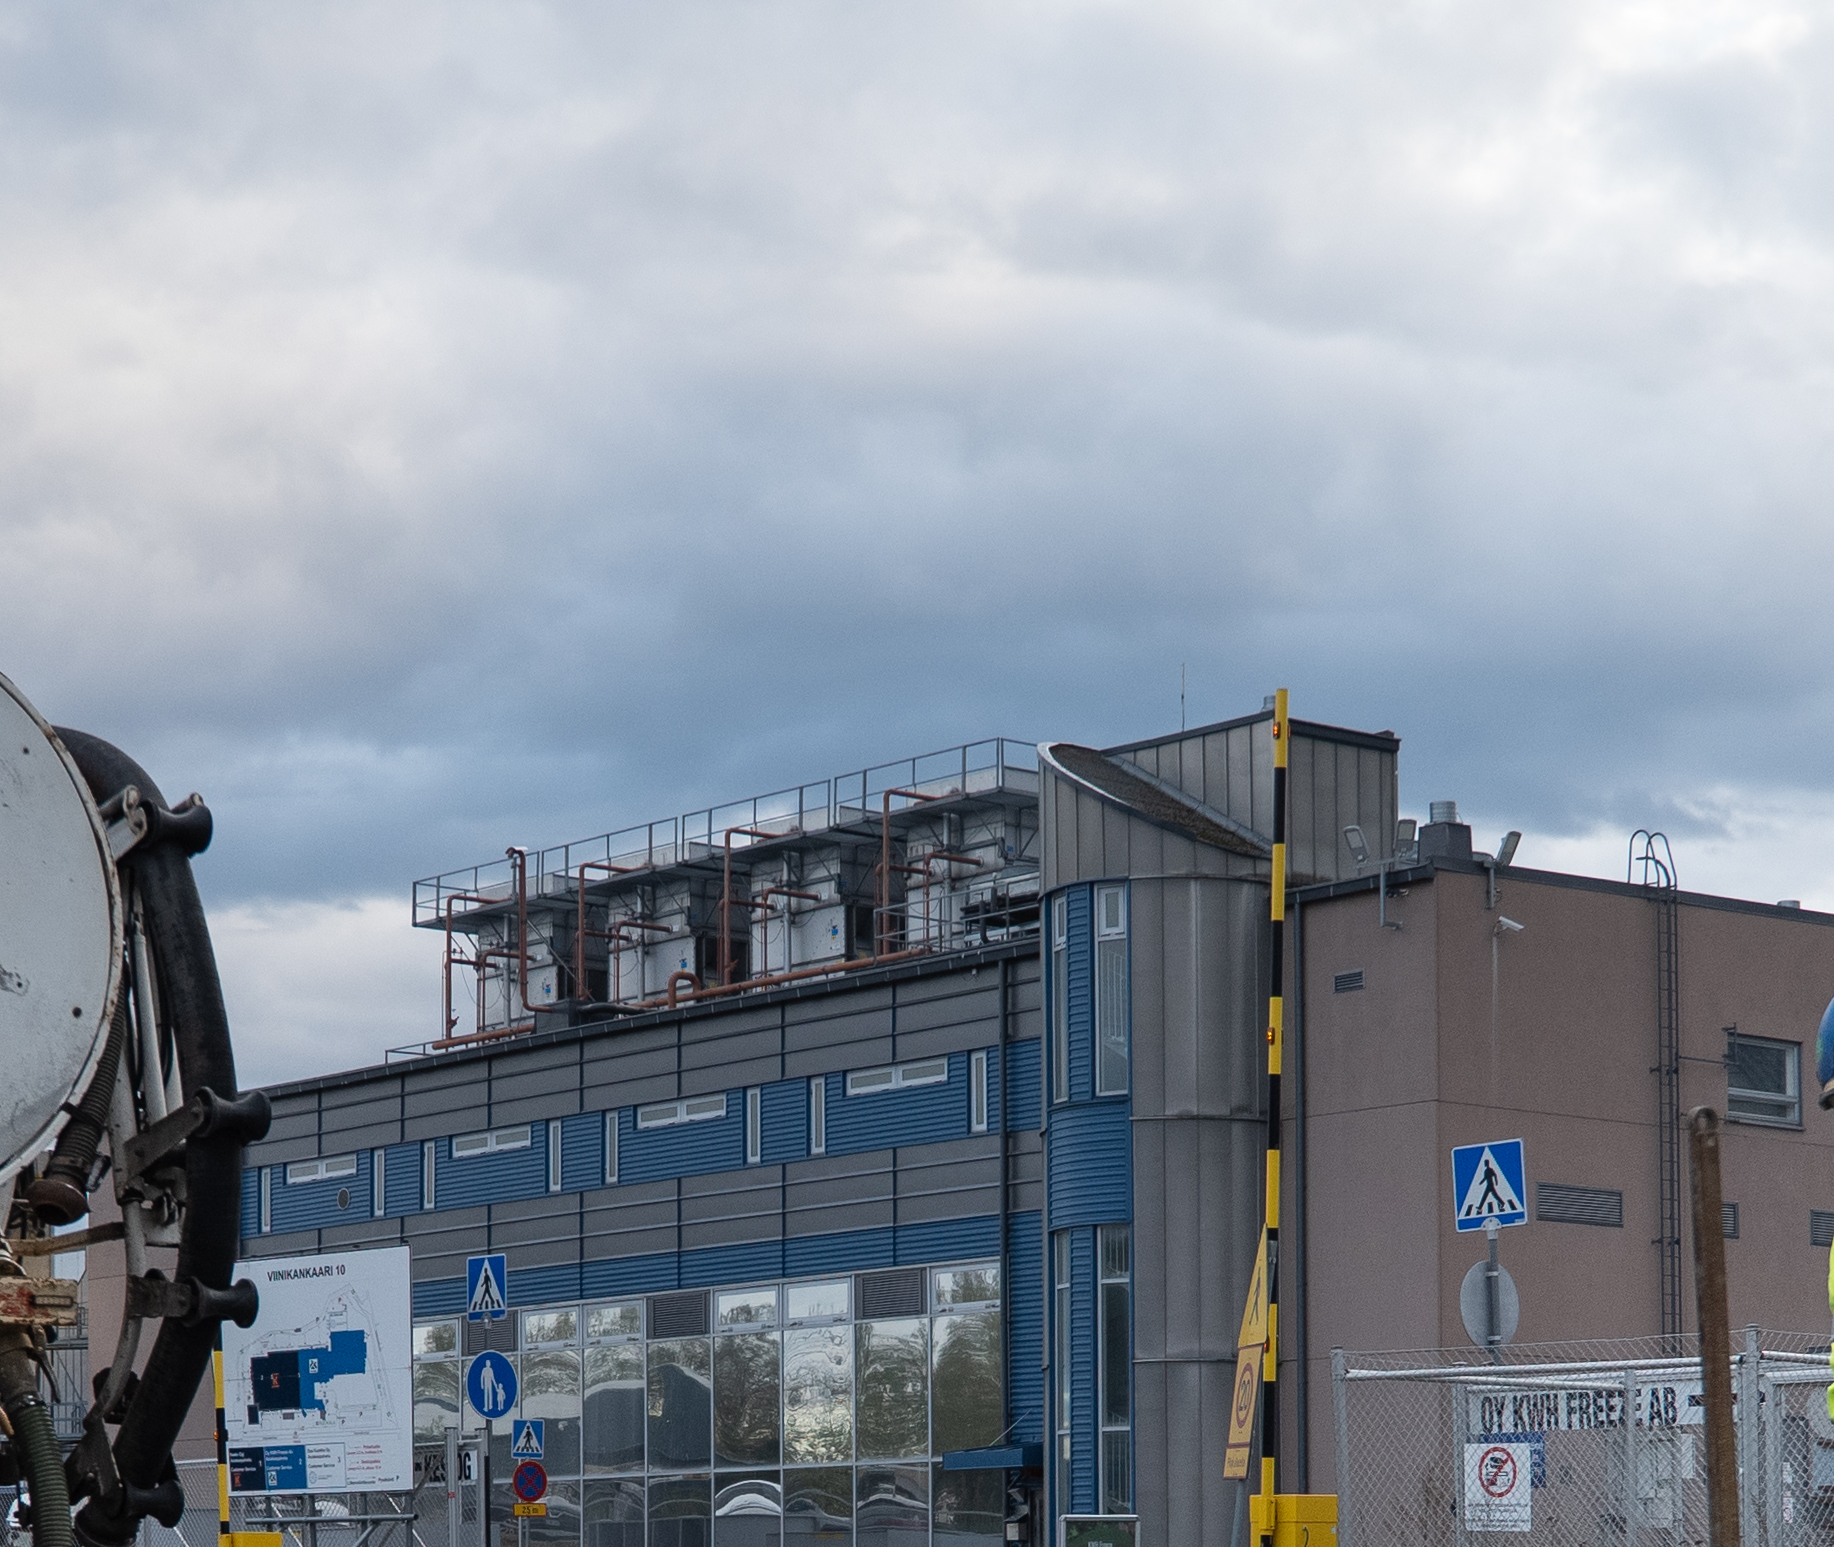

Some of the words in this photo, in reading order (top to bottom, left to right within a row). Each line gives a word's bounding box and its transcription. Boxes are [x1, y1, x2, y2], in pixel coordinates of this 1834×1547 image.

[267, 1265, 333, 1282] VIINIKANKAARI
[335, 1264, 346, 1276] 10
[1480, 1395, 1506, 1435] OY
[1512, 1393, 1561, 1432] KWH
[1648, 1386, 1679, 1427] AB
[522, 1506, 531, 1515] 25
